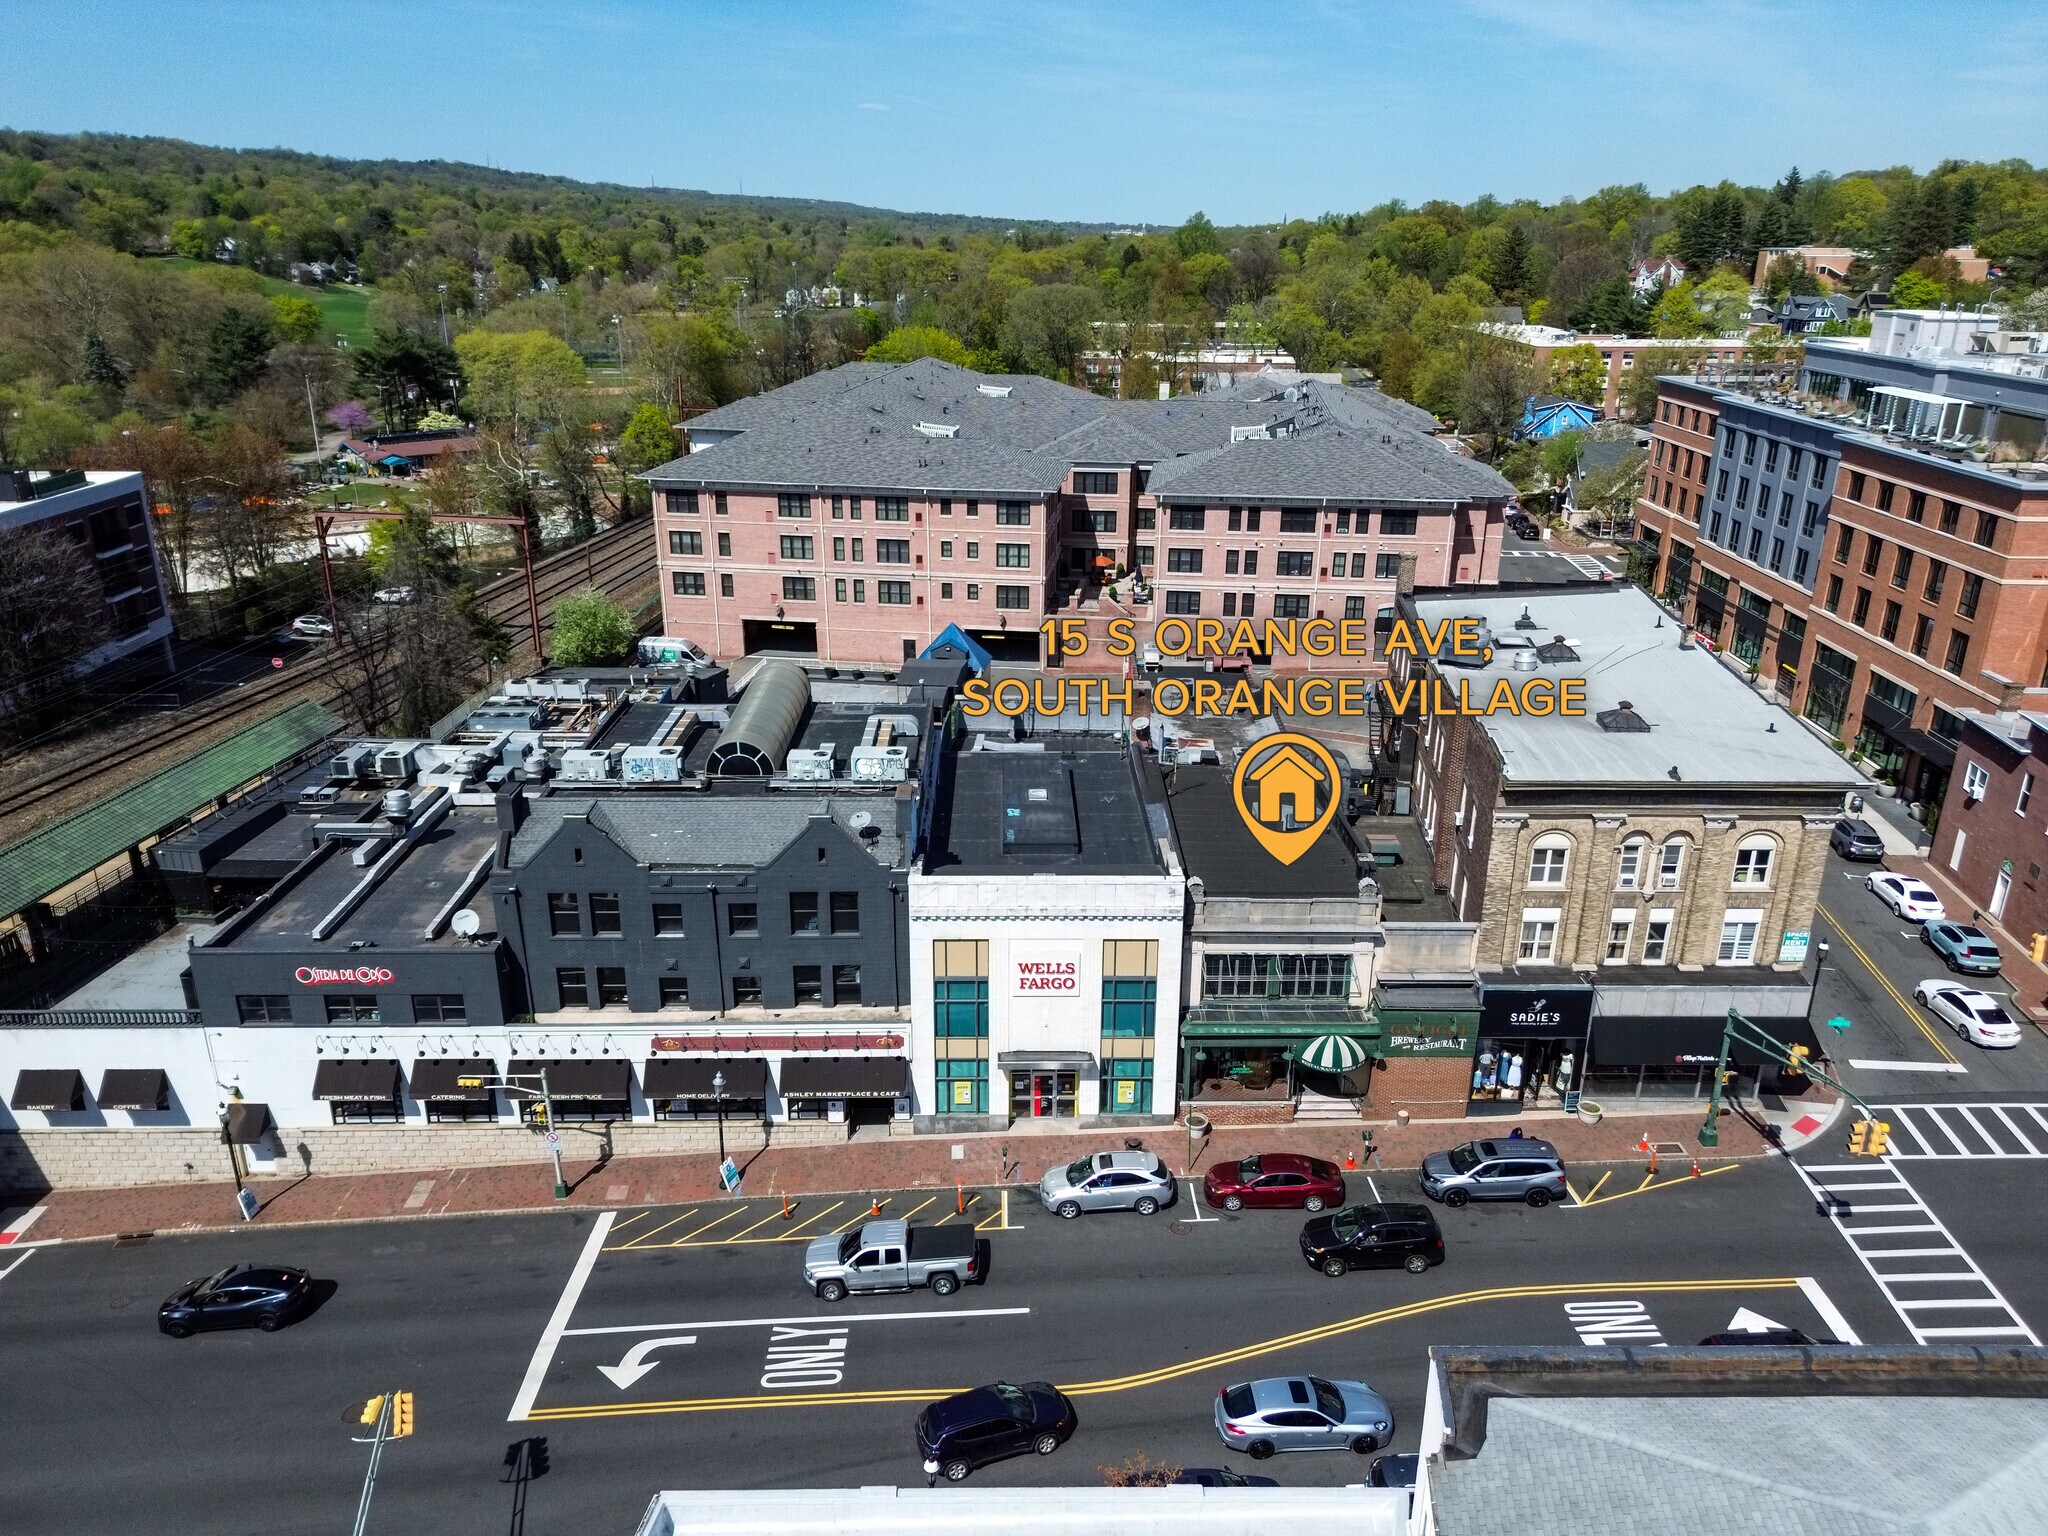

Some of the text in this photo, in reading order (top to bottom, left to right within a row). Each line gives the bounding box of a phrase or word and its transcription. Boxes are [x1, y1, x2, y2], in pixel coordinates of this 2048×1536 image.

[295, 966, 392, 984] OSTERIA DEL CORSO
[1017, 962, 1076, 975] WELLS
[1018, 977, 1076, 990] FARGO
[1510, 1012, 1560, 1022] SADIE'S
[1389, 1036, 1432, 1048] BREWERY
[1413, 1037, 1467, 1051] RESTAURANT
[1564, 1300, 1668, 1347] ONL
[760, 1326, 849, 1388] ONLY
